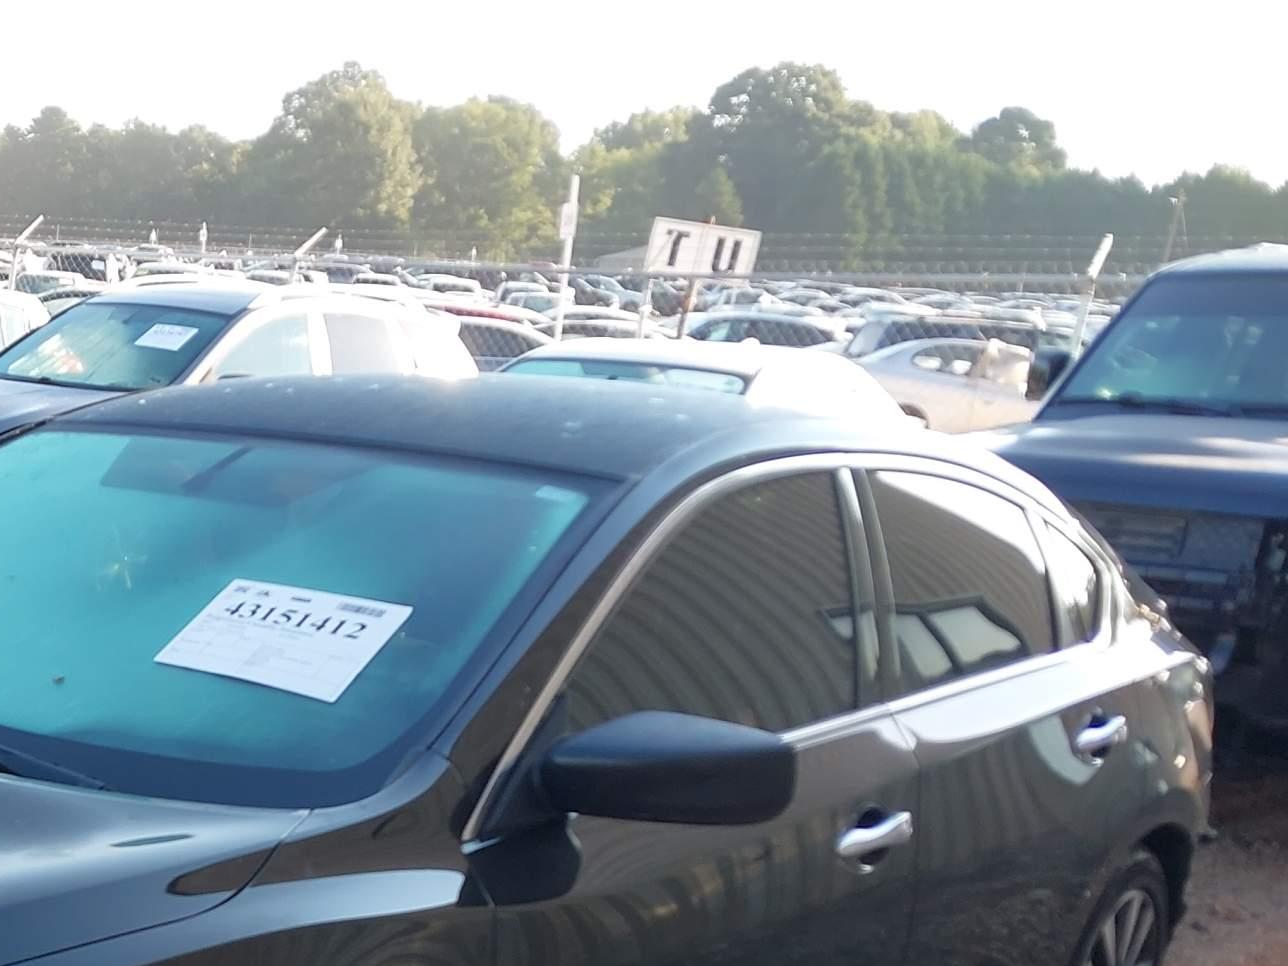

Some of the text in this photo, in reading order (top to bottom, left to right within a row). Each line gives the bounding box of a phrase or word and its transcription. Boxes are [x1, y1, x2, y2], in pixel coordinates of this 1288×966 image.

[666, 229, 743, 272] T U
[224, 600, 368, 640] 43151412
